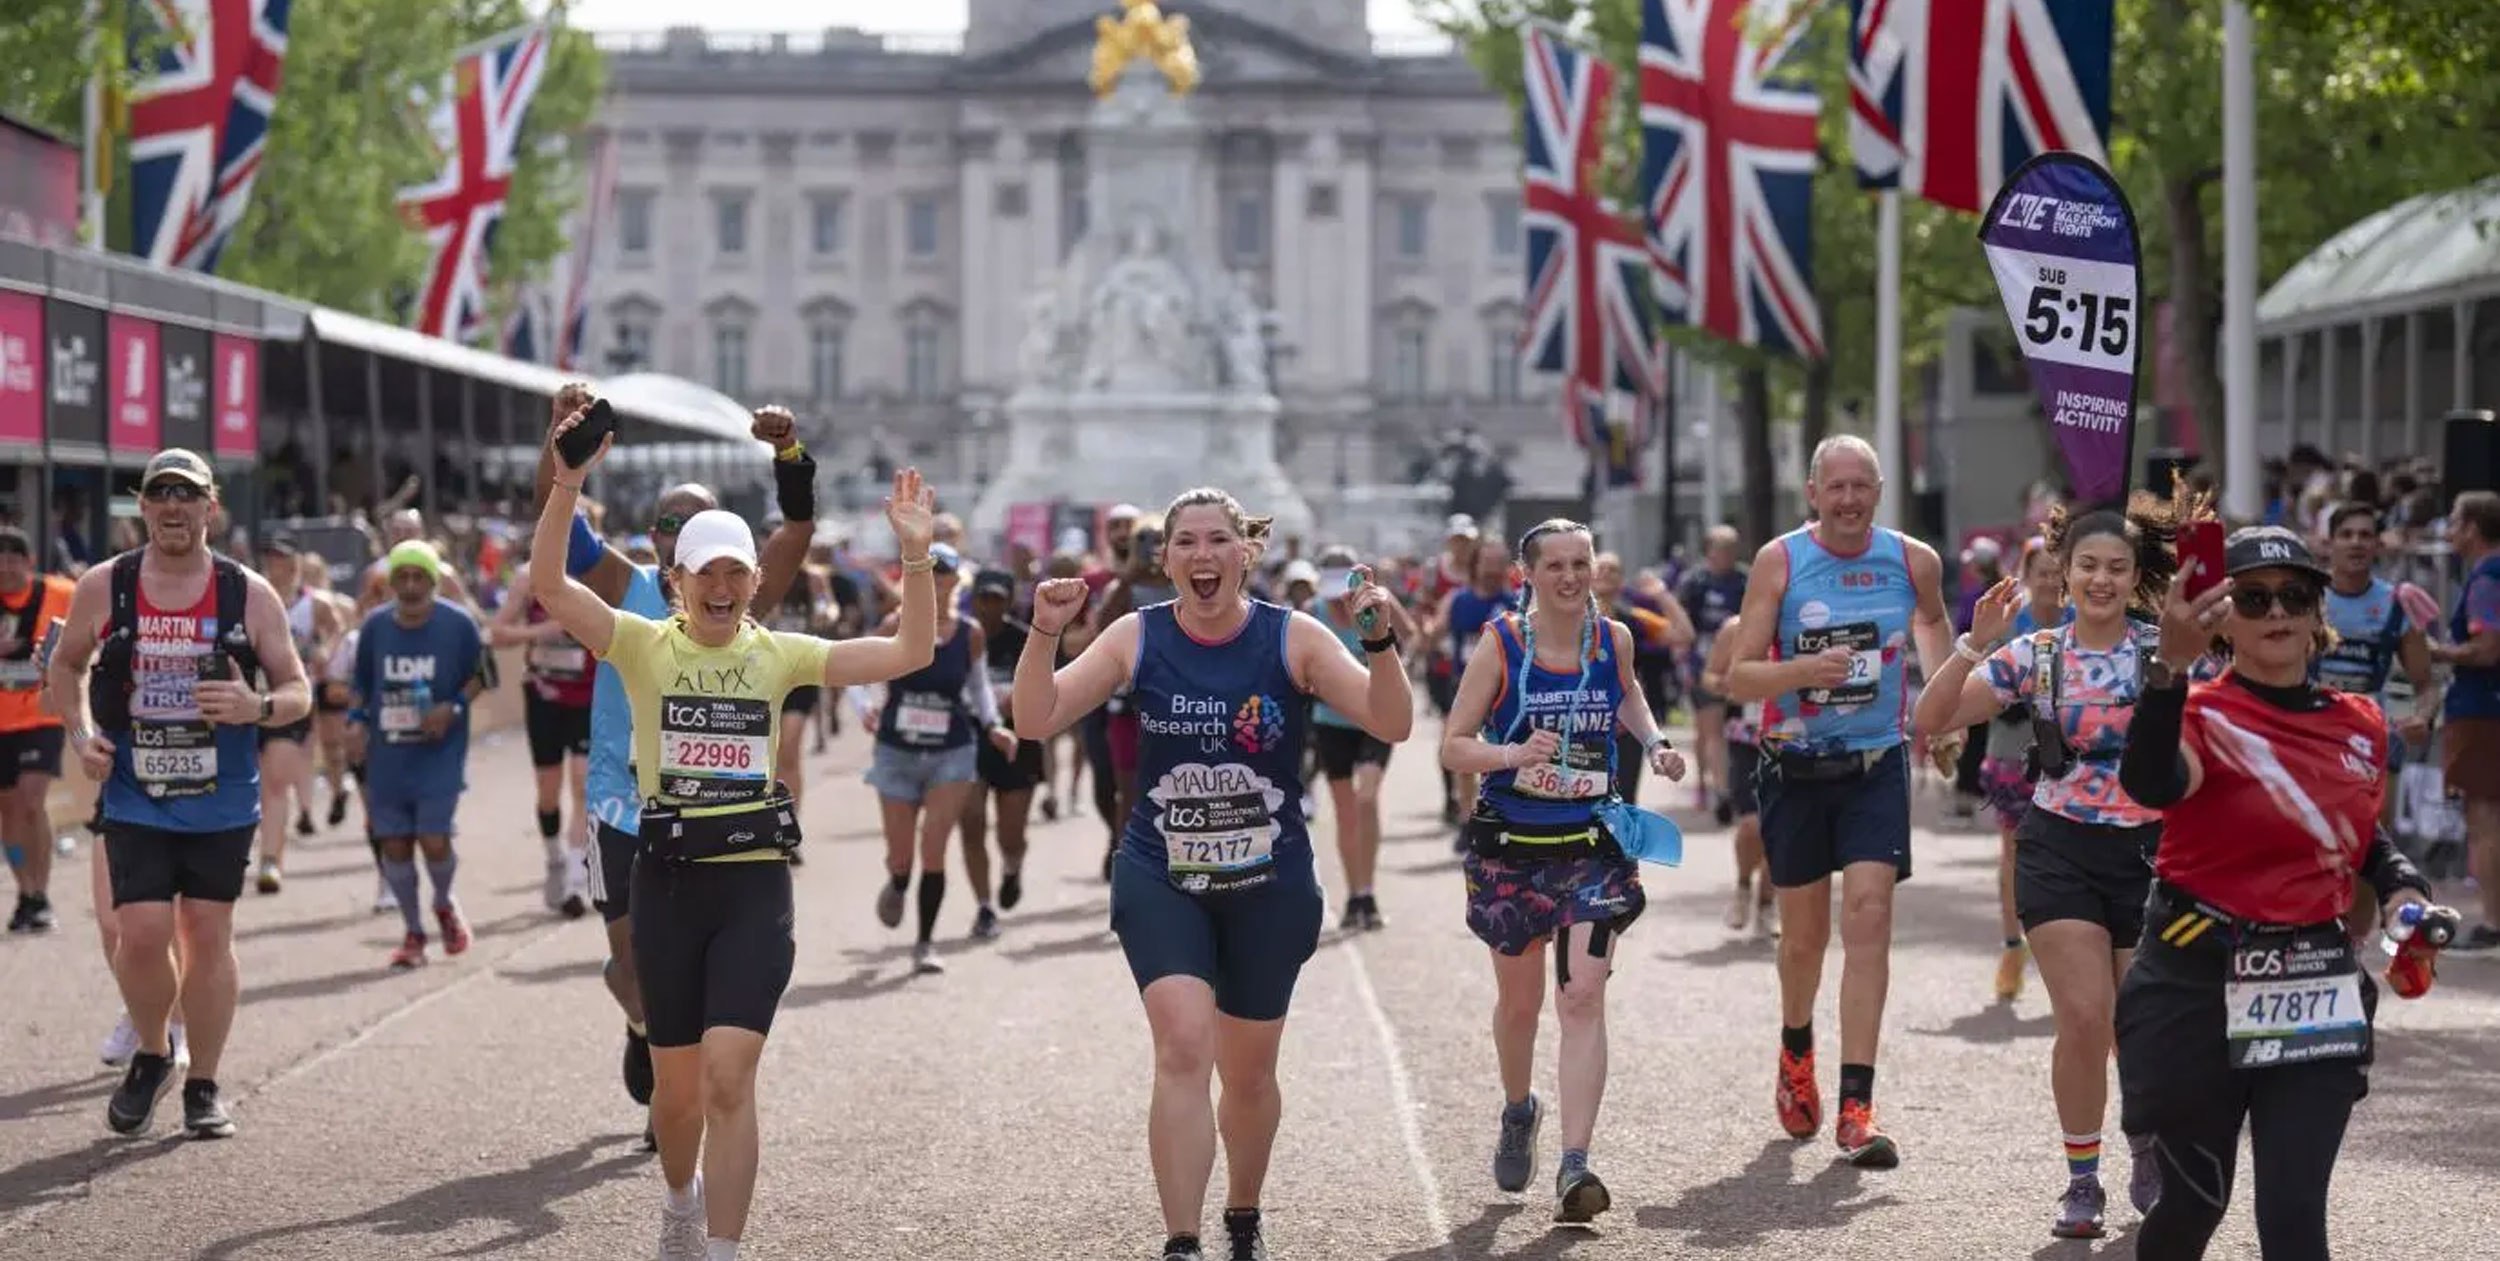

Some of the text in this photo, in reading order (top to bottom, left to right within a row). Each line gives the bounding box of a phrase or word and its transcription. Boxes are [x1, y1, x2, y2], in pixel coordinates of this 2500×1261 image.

[2055, 211, 2118, 229] MARATHON
[2059, 200, 2104, 215] LONDON
[2052, 221, 2093, 238] EVENTS
[2039, 267, 2067, 285] SUB
[2024, 286, 2131, 356] 5:15
[2057, 389, 2128, 417] INSPIRING
[2053, 408, 2123, 434] ACTIVITY
[137, 616, 197, 637] MARTIN
[384, 655, 436, 681] LDN
[674, 668, 752, 694] ALYX
[1171, 694, 1227, 715] Brain
[1591, 689, 1608, 702] UK
[668, 702, 707, 727] tcs
[1140, 711, 1227, 736] Research
[677, 741, 751, 769] 22996
[1200, 737, 1228, 753] UK
[145, 754, 203, 776] 65235
[1171, 768, 1251, 795] MAURA
[1531, 768, 1594, 797] 3642
[1169, 804, 1206, 827] tcs
[1181, 836, 1252, 863] 72177
[2247, 988, 2338, 1024] 47877
